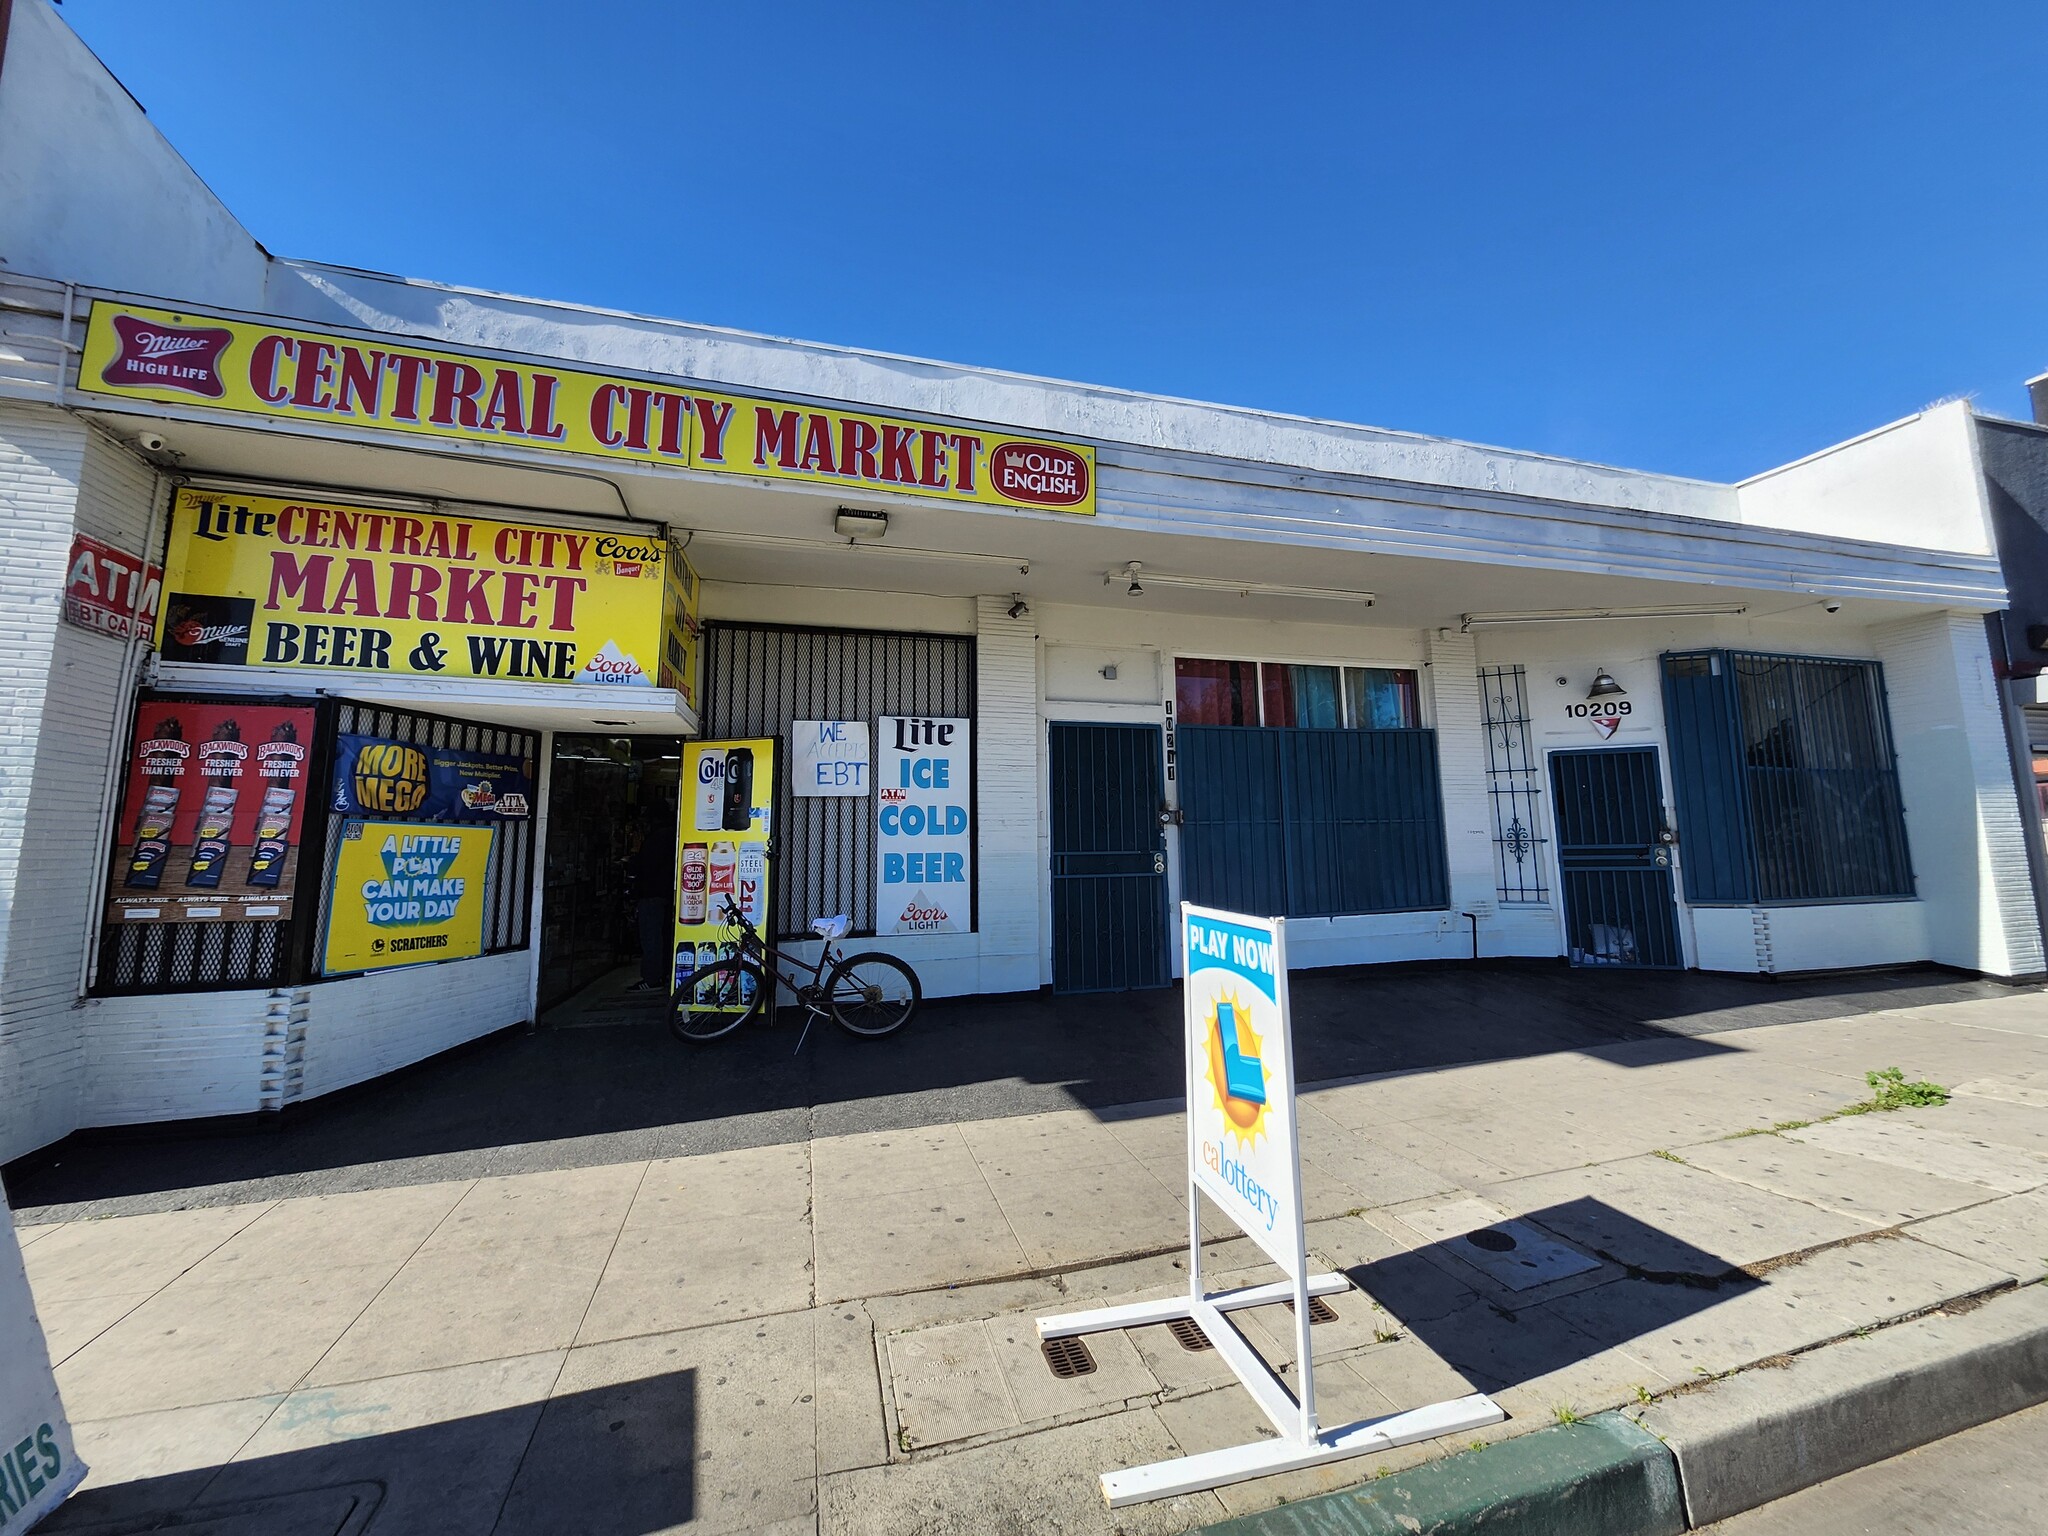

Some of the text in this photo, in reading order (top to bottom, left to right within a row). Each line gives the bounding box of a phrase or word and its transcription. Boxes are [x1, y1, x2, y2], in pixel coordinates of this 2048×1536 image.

[135, 332, 210, 358] Miller
[126, 359, 208, 381] HIGH LIFE
[249, 335, 983, 492] CENTRAL CITY MARKET
[1025, 453, 1076, 477] OLDE
[1003, 468, 1077, 495] ENGLISH
[193, 501, 276, 541] Lite
[277, 505, 590, 571] CENTRAL CITY
[595, 536, 661, 563] Coors
[616, 562, 641, 576] Banquet
[66, 550, 161, 617] ATM
[263, 551, 587, 632] MARKET
[108, 615, 150, 640] CAH
[189, 624, 247, 644] Miller
[262, 622, 577, 680] BEER & WINE
[585, 653, 643, 674] Coors
[594, 673, 633, 684] LIGHT
[1564, 701, 1632, 718] 10209
[819, 722, 847, 743] WE
[892, 718, 954, 753] Lite
[139, 738, 191, 759] BACKWOODS
[199, 740, 249, 760] BACKWOODS
[257, 741, 305, 761] BACKWOODS
[141, 766, 185, 776] THAN EVER
[145, 757, 182, 767] FRESHER
[200, 767, 243, 777] THAN EVER
[205, 759, 241, 768] FRESHER
[263, 760, 298, 769] FRESHER
[356, 744, 427, 782] MORE
[433, 758, 456, 767] Bigger
[485, 763, 503, 771] Better
[699, 757, 725, 784] Colt
[259, 769, 300, 778] THAN EVER
[459, 769, 473, 777] New
[816, 760, 868, 786] EBT
[900, 758, 949, 789] ICE
[355, 777, 427, 812] MEGA
[881, 788, 906, 797] ATM
[879, 804, 968, 836] COLD
[381, 834, 461, 853] A LITTLE
[687, 850, 703, 860] 24
[740, 859, 762, 868] STEEL
[392, 856, 443, 876] PLAY
[683, 872, 705, 881] ENGLISH
[686, 865, 702, 873] OLDE
[883, 852, 966, 884] BEER
[362, 878, 465, 899] CAN MAKE
[739, 880, 756, 912] 211
[365, 899, 460, 922] YOUR DAY
[900, 902, 949, 922] Coors
[908, 920, 940, 930] LIGHT
[390, 934, 448, 952] SCRATCHERS
[1190, 923, 1275, 976] PLAY NOW
[1202, 1140, 1279, 1231] calottery
